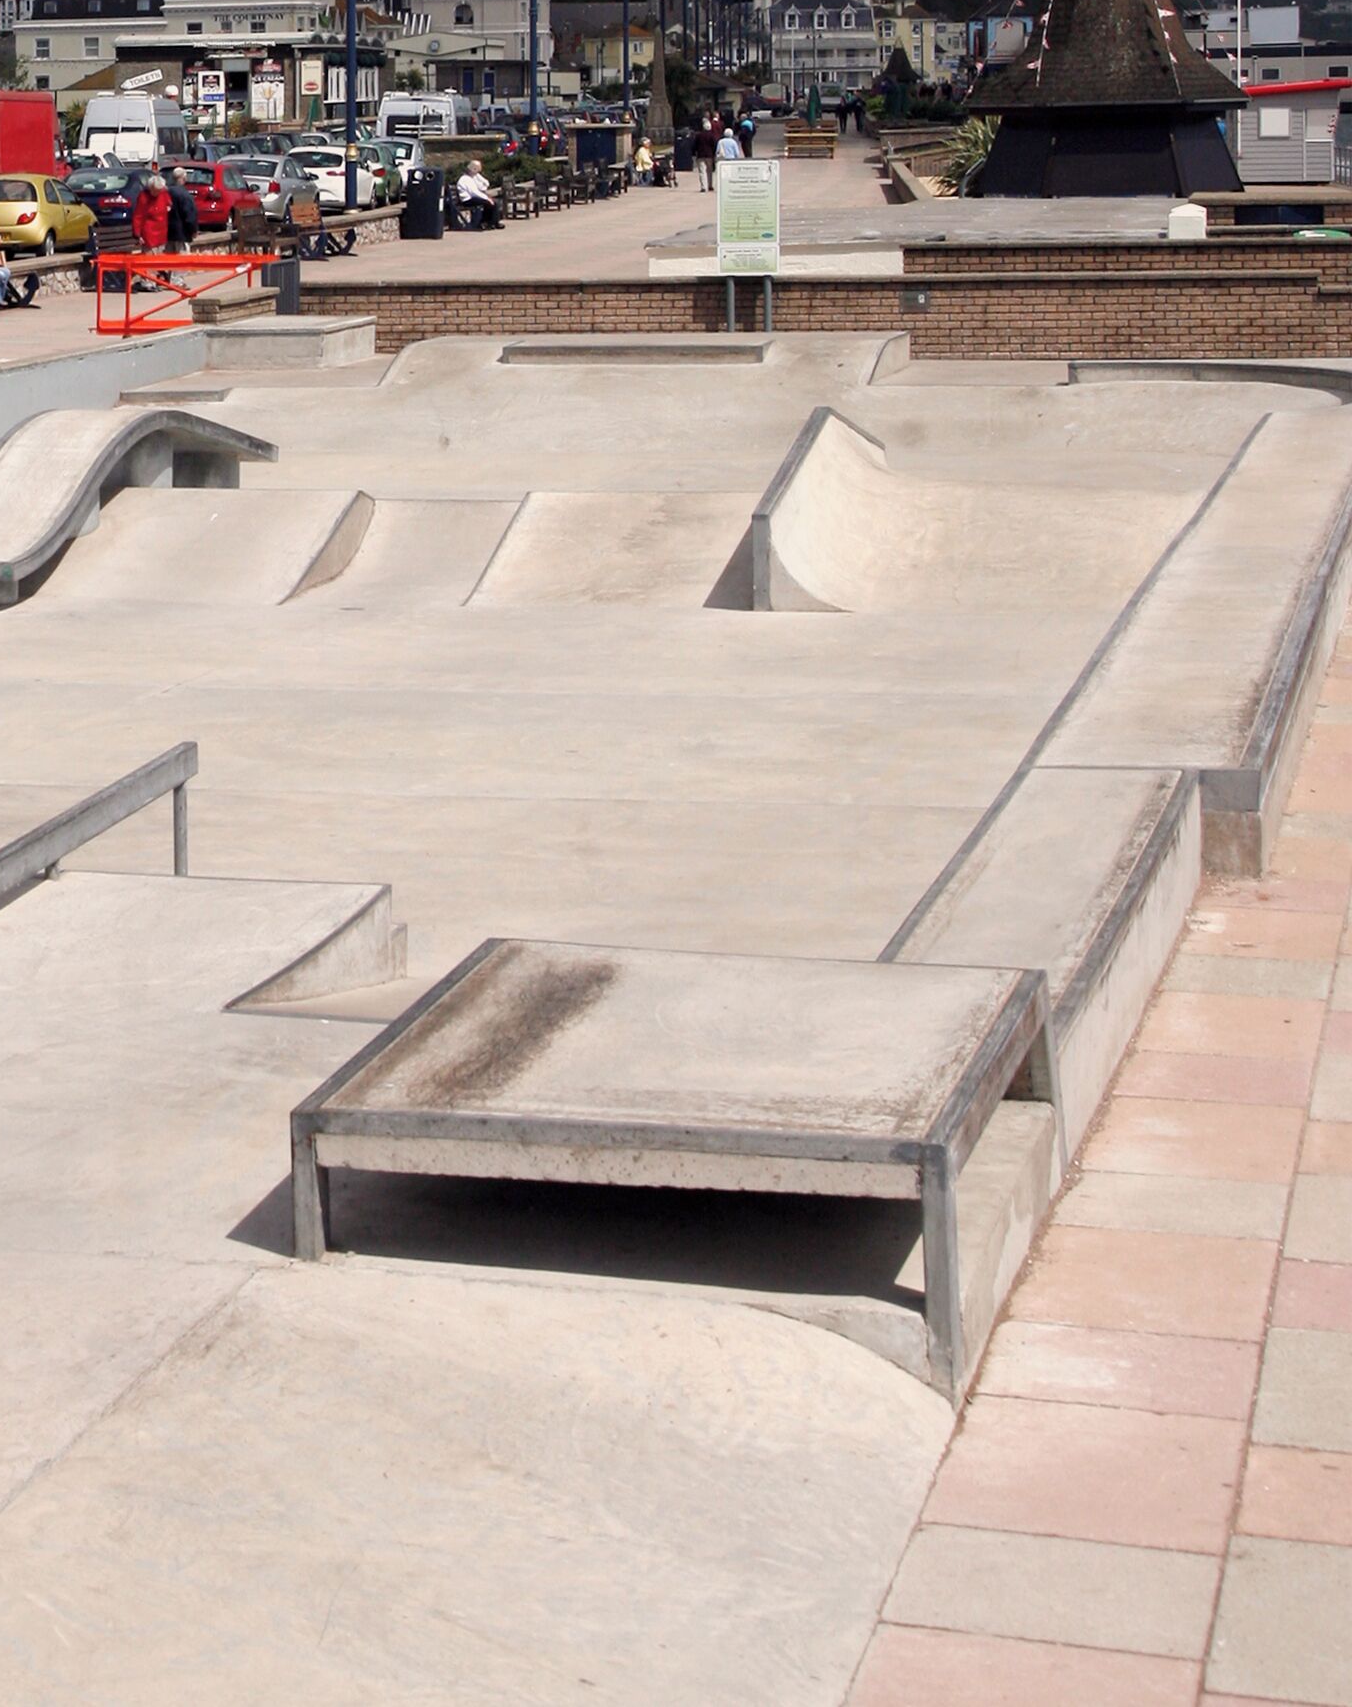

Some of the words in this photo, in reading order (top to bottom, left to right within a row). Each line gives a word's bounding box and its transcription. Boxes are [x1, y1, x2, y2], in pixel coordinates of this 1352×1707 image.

[214, 14, 231, 22] THE
[233, 13, 285, 22] COURTENAY
[130, 72, 161, 86] TOILETS
